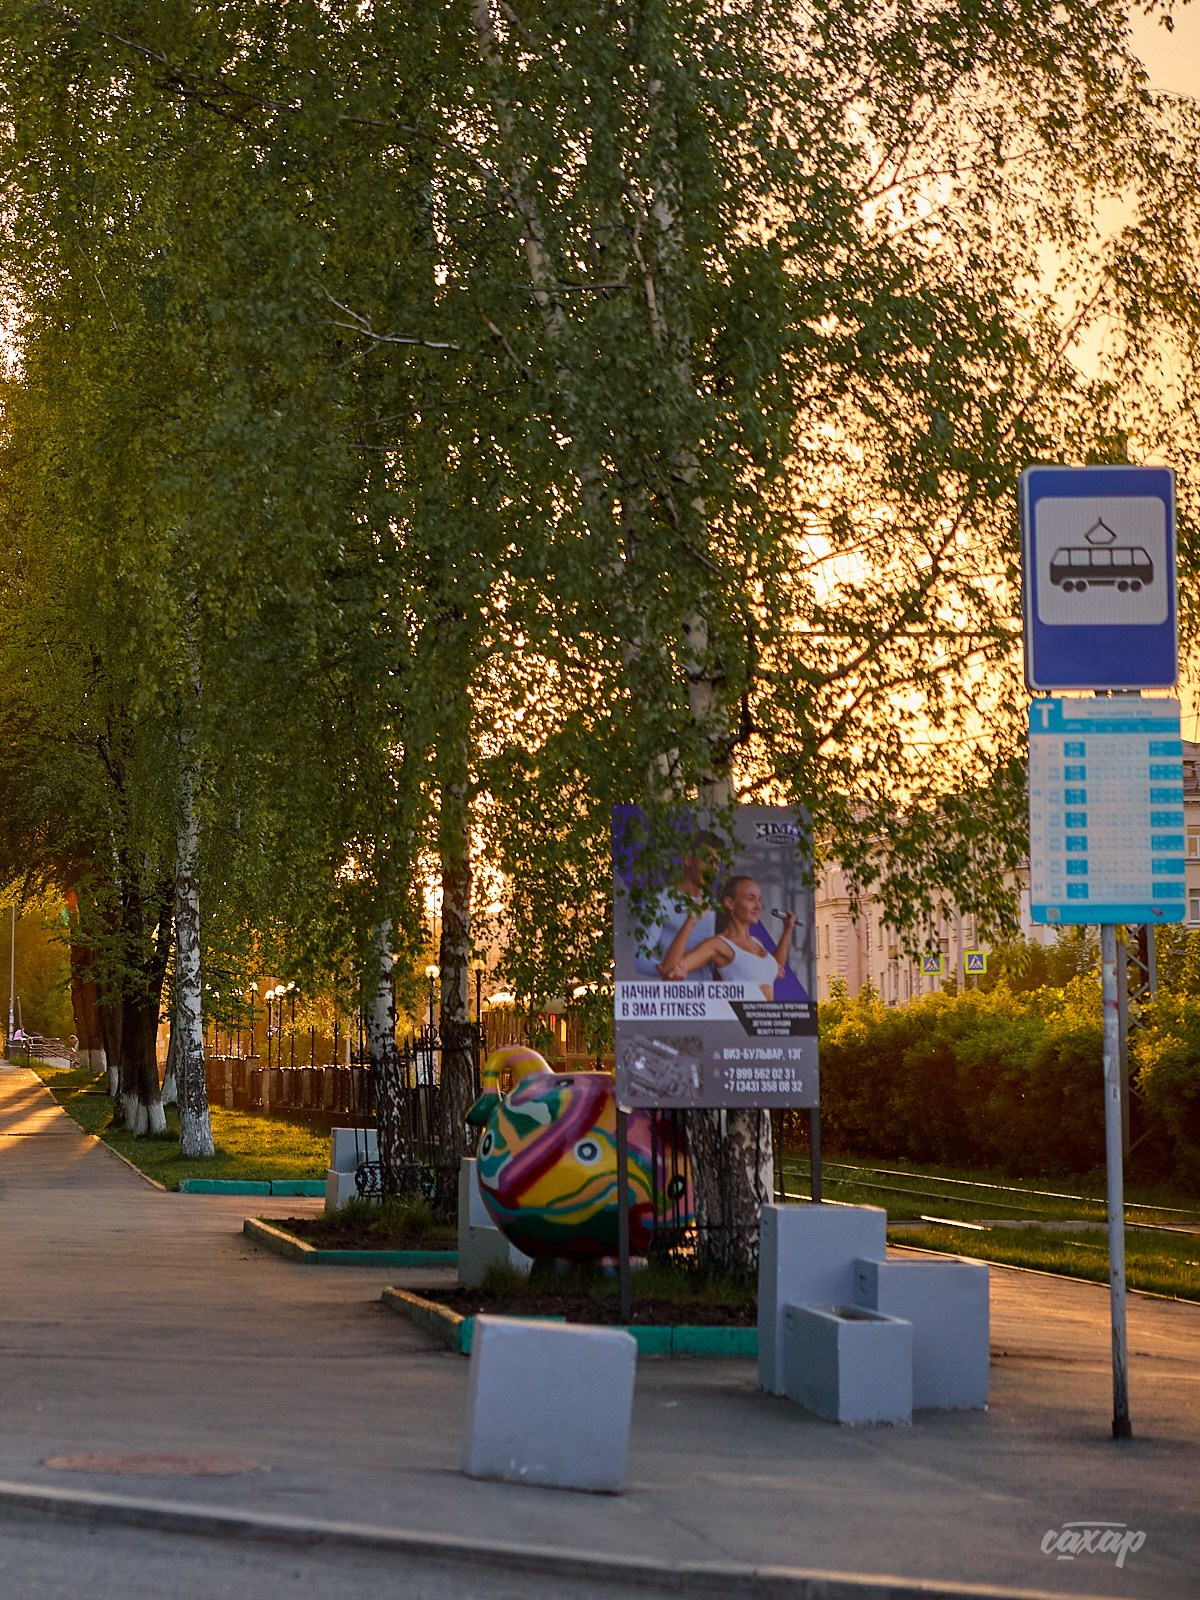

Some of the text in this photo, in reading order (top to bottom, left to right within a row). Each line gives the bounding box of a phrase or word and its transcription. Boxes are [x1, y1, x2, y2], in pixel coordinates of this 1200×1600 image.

[622, 982, 744, 999] НАЧНИ НОВЫЙ СЕЗОН
[622, 1002, 706, 1017] В ЭМА FITNESS
[723, 1068, 796, 1079] +7 999 562 02 31
[723, 1081, 735, 1092] +7
[736, 1081, 760, 1093] (343)
[791, 1081, 803, 1092] 32
